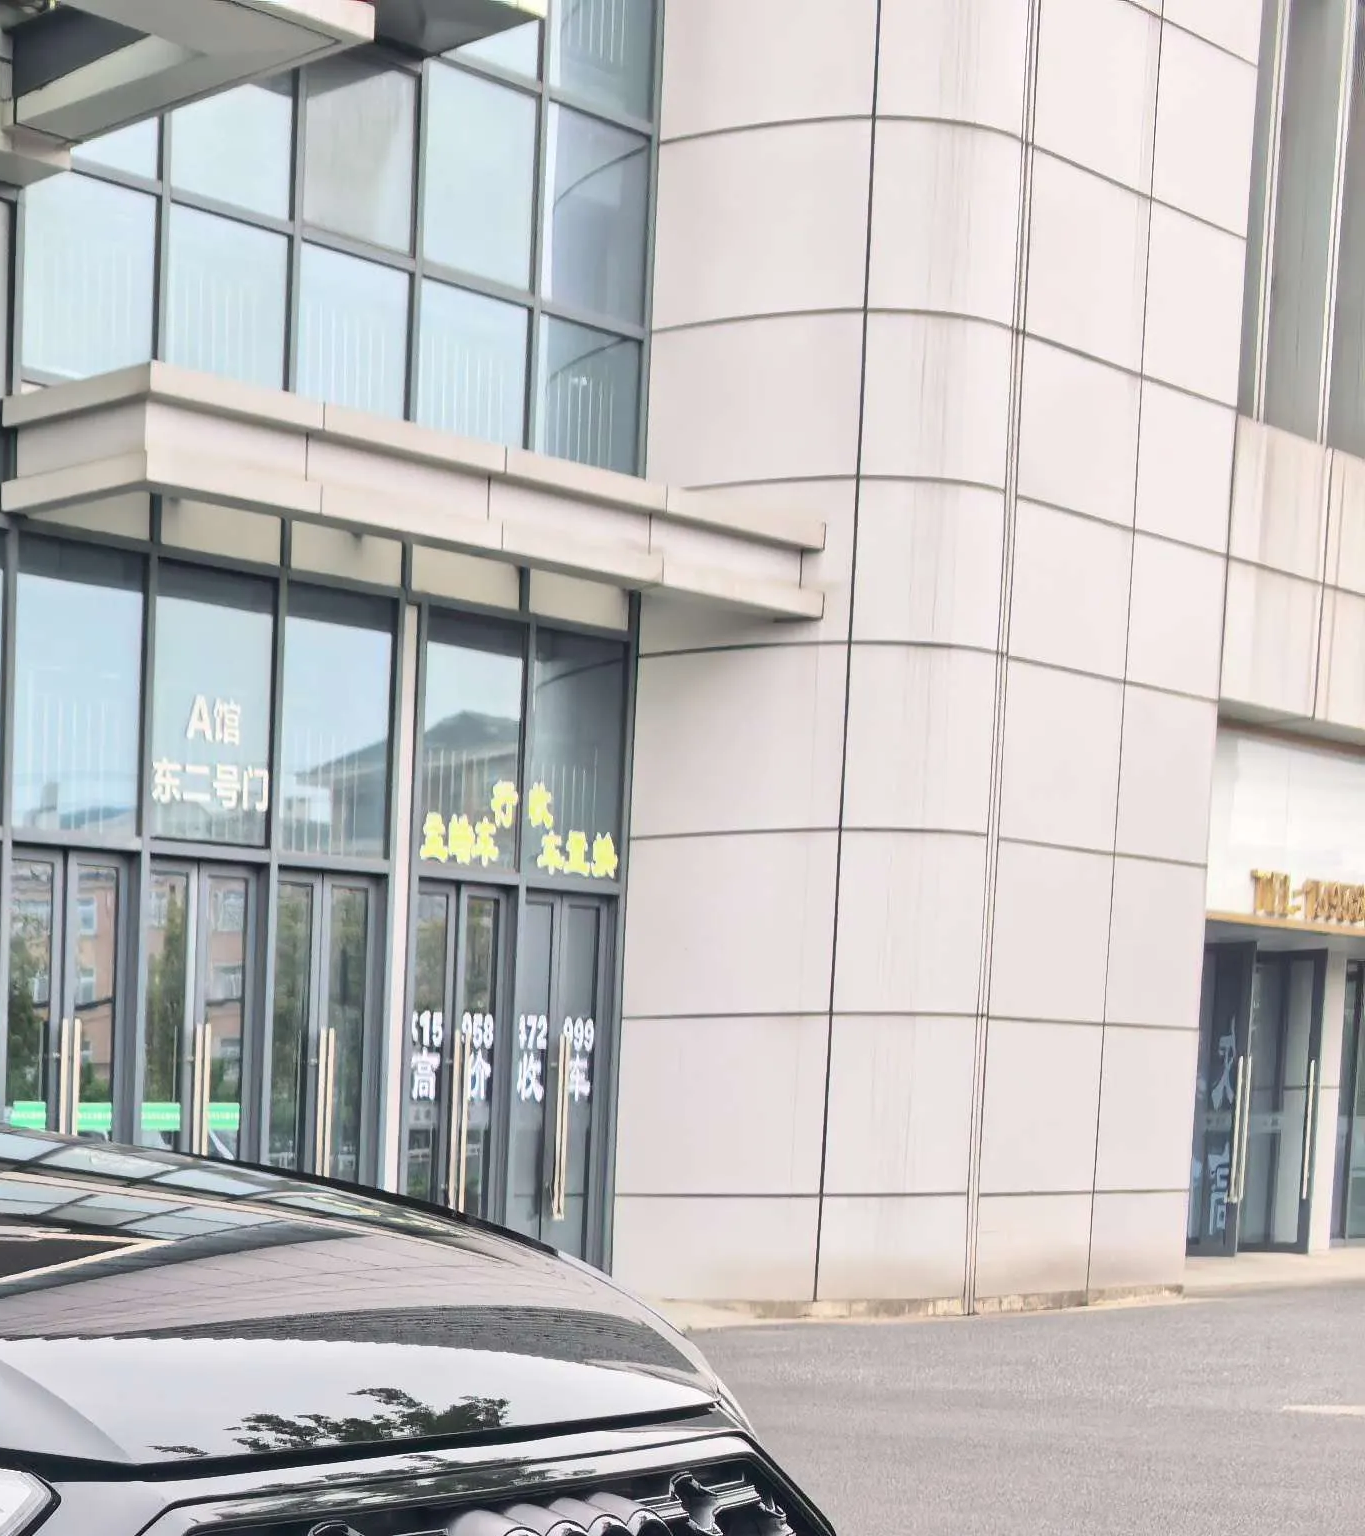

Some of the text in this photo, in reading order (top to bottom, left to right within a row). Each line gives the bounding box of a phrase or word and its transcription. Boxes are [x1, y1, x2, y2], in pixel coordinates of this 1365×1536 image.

[186, 694, 241, 745] A馆
[151, 757, 269, 812] 东二号门
